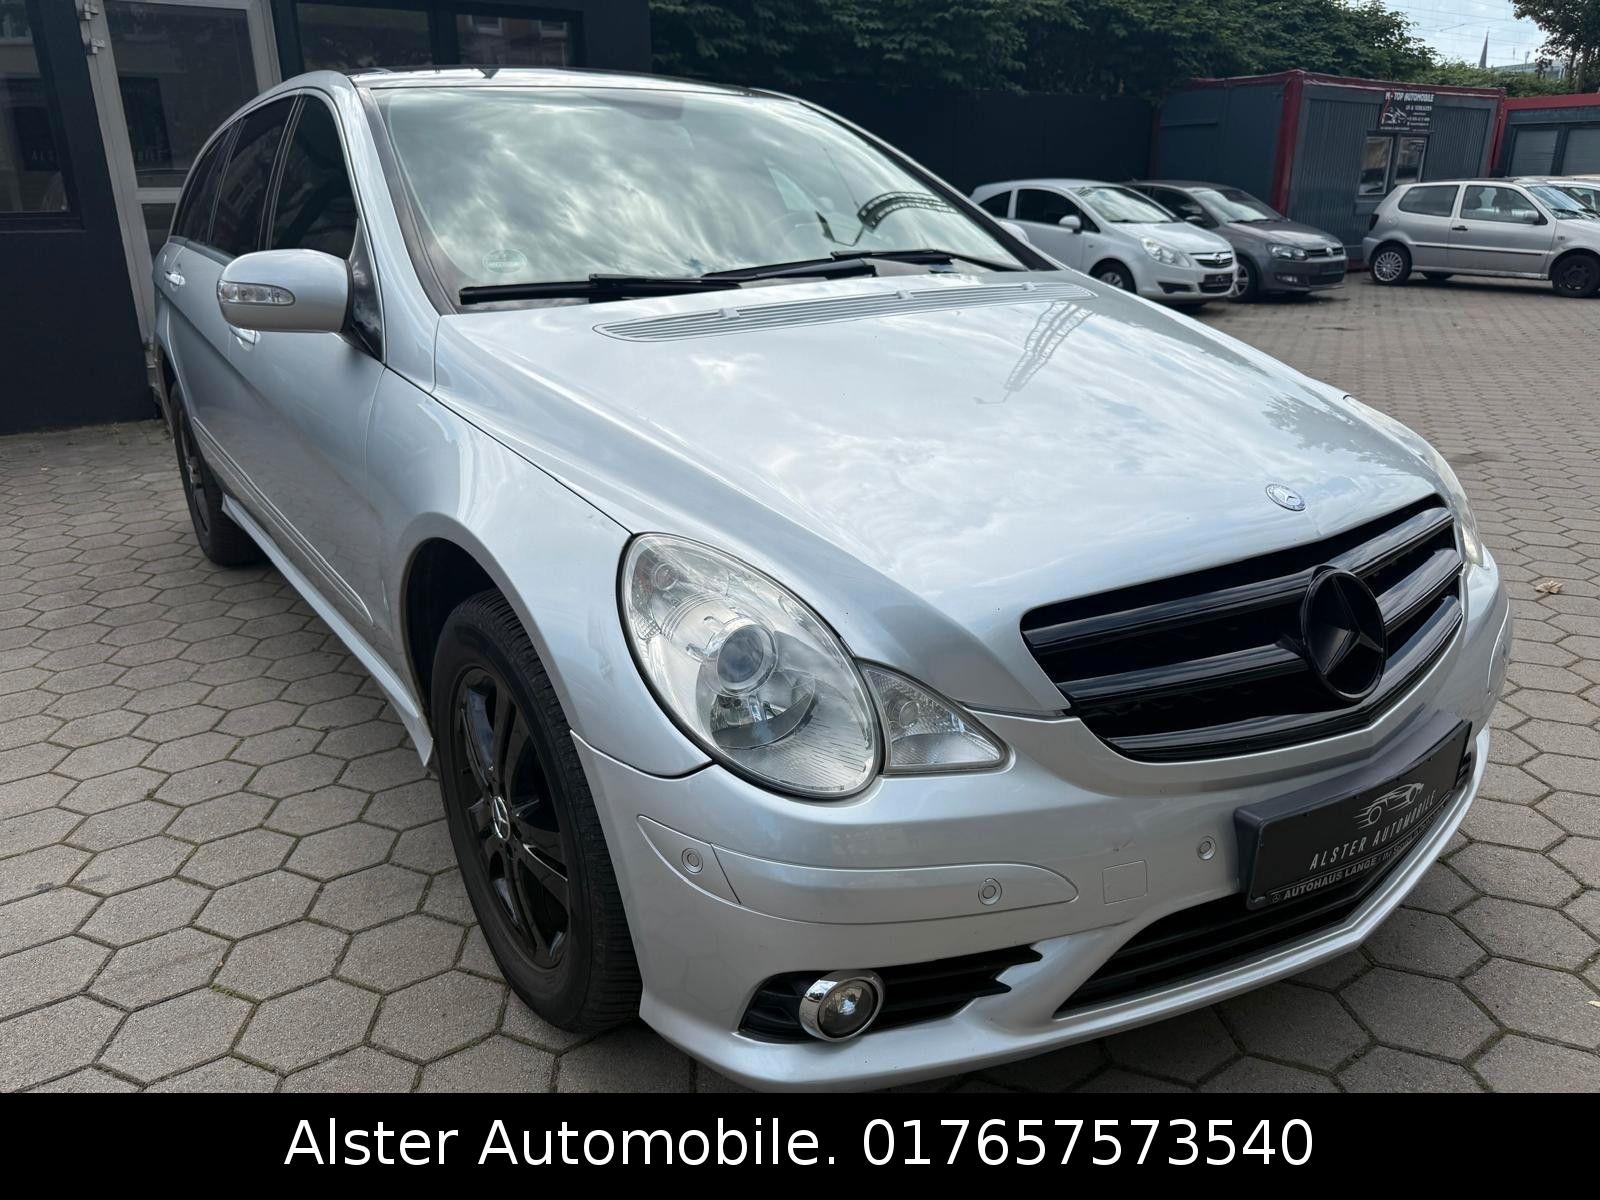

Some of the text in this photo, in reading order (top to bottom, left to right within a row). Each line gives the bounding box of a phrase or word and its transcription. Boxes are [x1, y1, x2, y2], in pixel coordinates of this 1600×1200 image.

[1404, 92, 1435, 103] AUTOMOBILE
[1309, 836, 1367, 871] ALSTER
[1371, 789, 1436, 847] AUTOMOBILE
[1283, 871, 1343, 900] AUTOHAUS
[1344, 857, 1377, 878] LANGE
